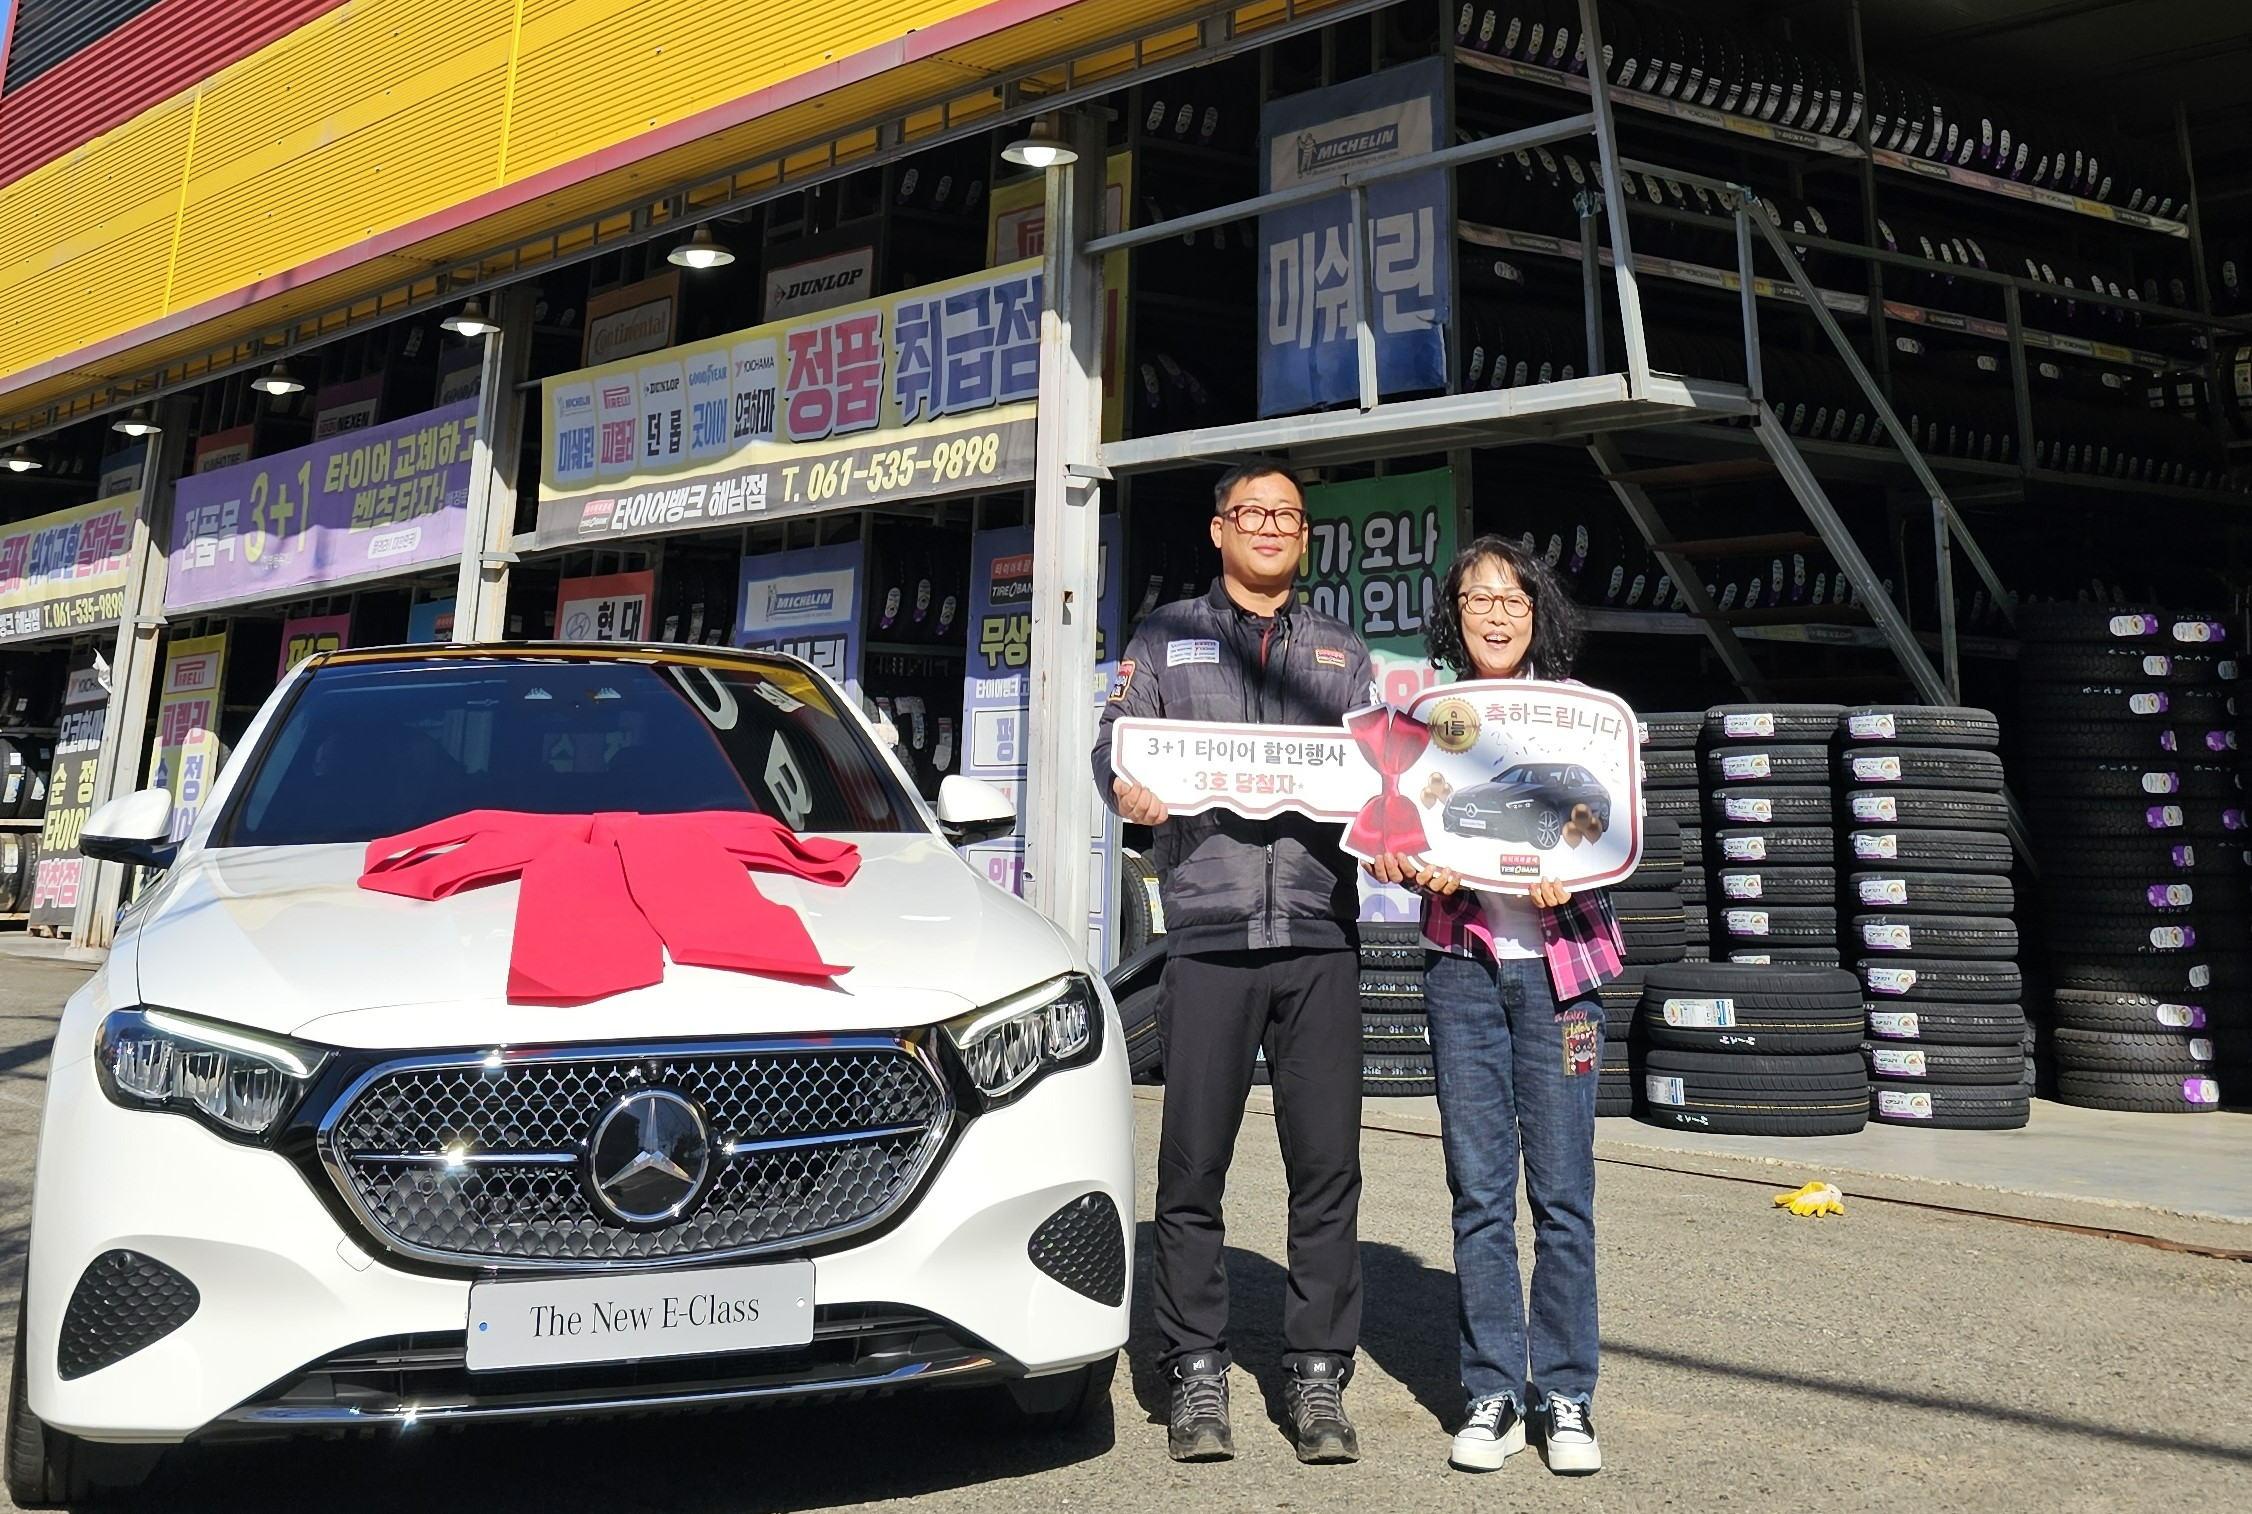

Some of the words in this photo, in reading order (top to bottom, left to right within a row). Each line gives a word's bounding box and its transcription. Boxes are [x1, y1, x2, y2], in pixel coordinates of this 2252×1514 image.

[1317, 128, 1395, 160] MICHELIN
[787, 268, 863, 299] DUNLOP
[1268, 206, 1435, 349] 미쉐린
[688, 364, 728, 387] GOODYEAR
[786, 314, 880, 435] 정품
[895, 273, 1043, 420] 취급점
[602, 386, 631, 410] PIRELLI
[650, 377, 680, 394] DUNLOP
[336, 410, 370, 431] NEXEN
[691, 398, 728, 450] 굿이어
[734, 387, 776, 439] 요코하마
[558, 425, 595, 473] 미쉐린
[601, 418, 637, 464] 피렐리
[323, 440, 391, 493] 타이어
[611, 485, 707, 531] 타이어뱅크
[708, 473, 767, 516] 해남점
[782, 466, 799, 502] T.
[807, 433, 1000, 499] 061-535-9898
[181, 499, 241, 571] 전품목
[244, 460, 312, 564] 3+1
[1361, 511, 1438, 569] 오나
[15, 607, 41, 634] 해남점
[53, 591, 124, 628] 061-535-9898
[777, 592, 831, 609] MICHELIN
[1364, 576, 1434, 633] 오나
[980, 615, 1032, 667] 무상
[174, 660, 206, 687] PIRELLI
[55, 708, 106, 756] 요코하마
[162, 699, 211, 748] 피렐리
[1443, 719, 1466, 737] 1등
[1484, 702, 1622, 741] 축하드립니다
[1147, 737, 1186, 758] 3+1
[1195, 738, 1256, 763] 타이어
[1264, 741, 1347, 767] 할인행사
[1194, 770, 1229, 792] 3호
[1235, 771, 1296, 795] 당첨자
[530, 1304, 583, 1338] The
[591, 1301, 654, 1335] New
[661, 1294, 760, 1329] E-Class
